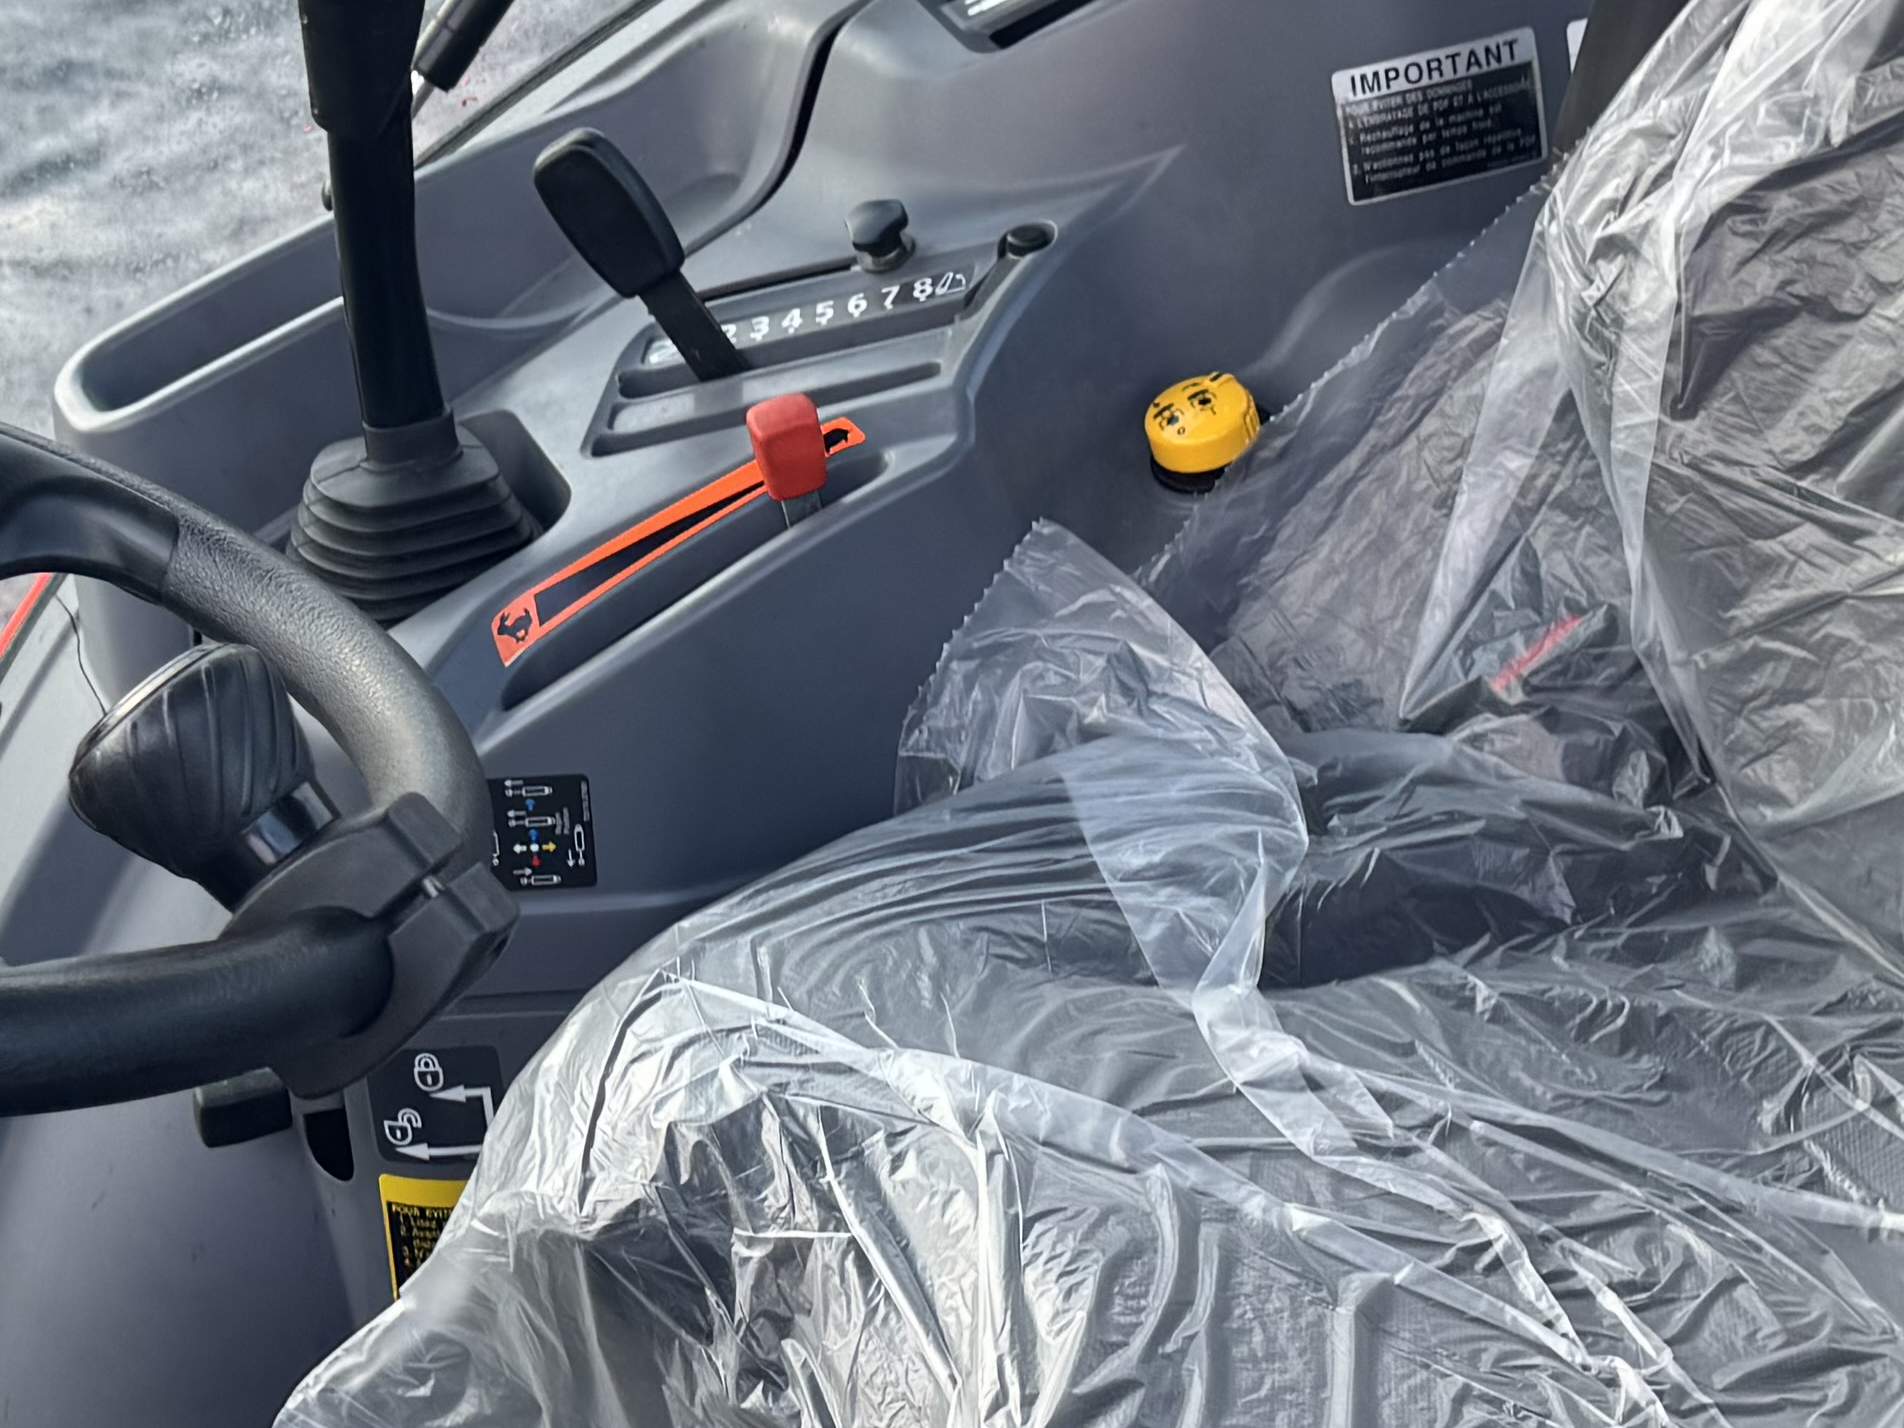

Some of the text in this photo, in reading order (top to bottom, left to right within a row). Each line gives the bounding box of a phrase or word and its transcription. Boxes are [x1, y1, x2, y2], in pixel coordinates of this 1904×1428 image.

[1350, 39, 1518, 96] IMPORTANT
[752, 316, 770, 334] 3
[781, 309, 802, 328] 4
[815, 302, 834, 321] 5
[847, 294, 867, 314] 6
[880, 286, 900, 305] 7
[913, 278, 932, 299] 8
